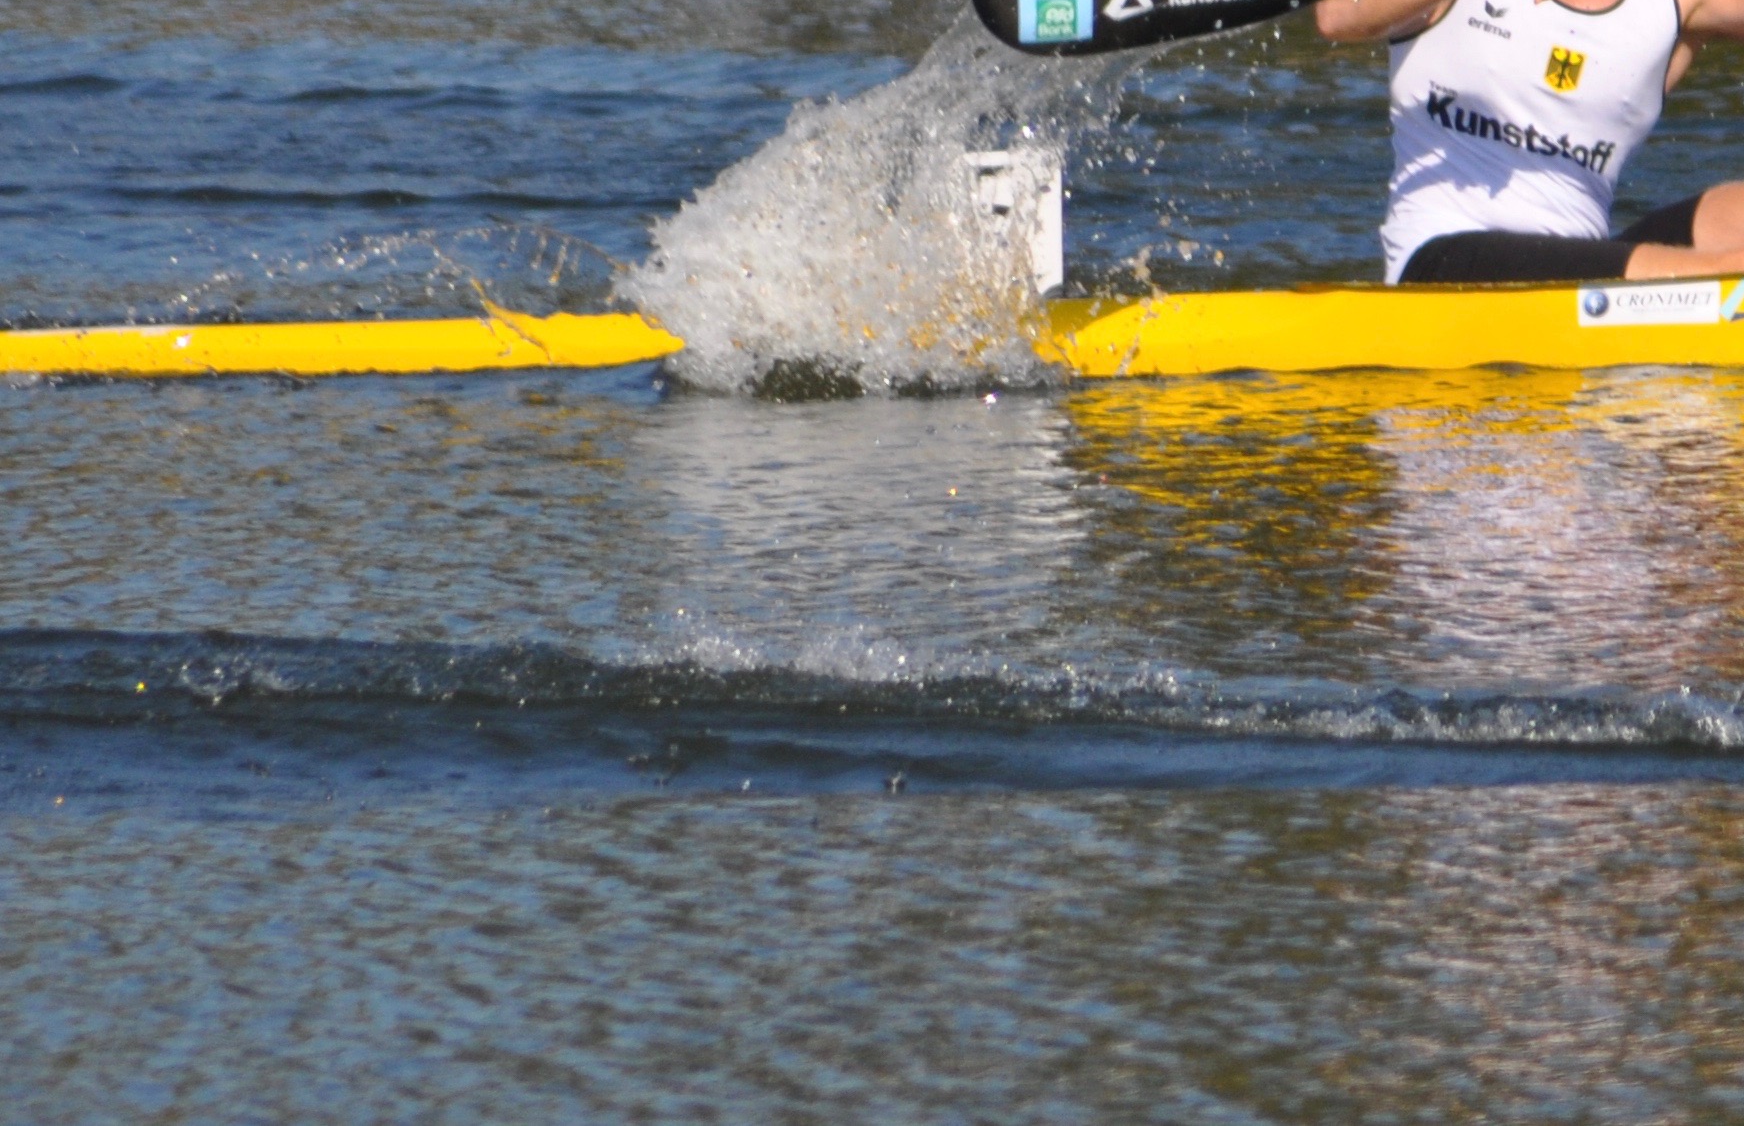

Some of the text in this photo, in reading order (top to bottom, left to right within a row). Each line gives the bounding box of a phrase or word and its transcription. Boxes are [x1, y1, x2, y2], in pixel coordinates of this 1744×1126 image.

[1468, 16, 1511, 40] erima
[1426, 90, 1616, 174] Kunststoff
[1616, 290, 1714, 307] CRONIMET
